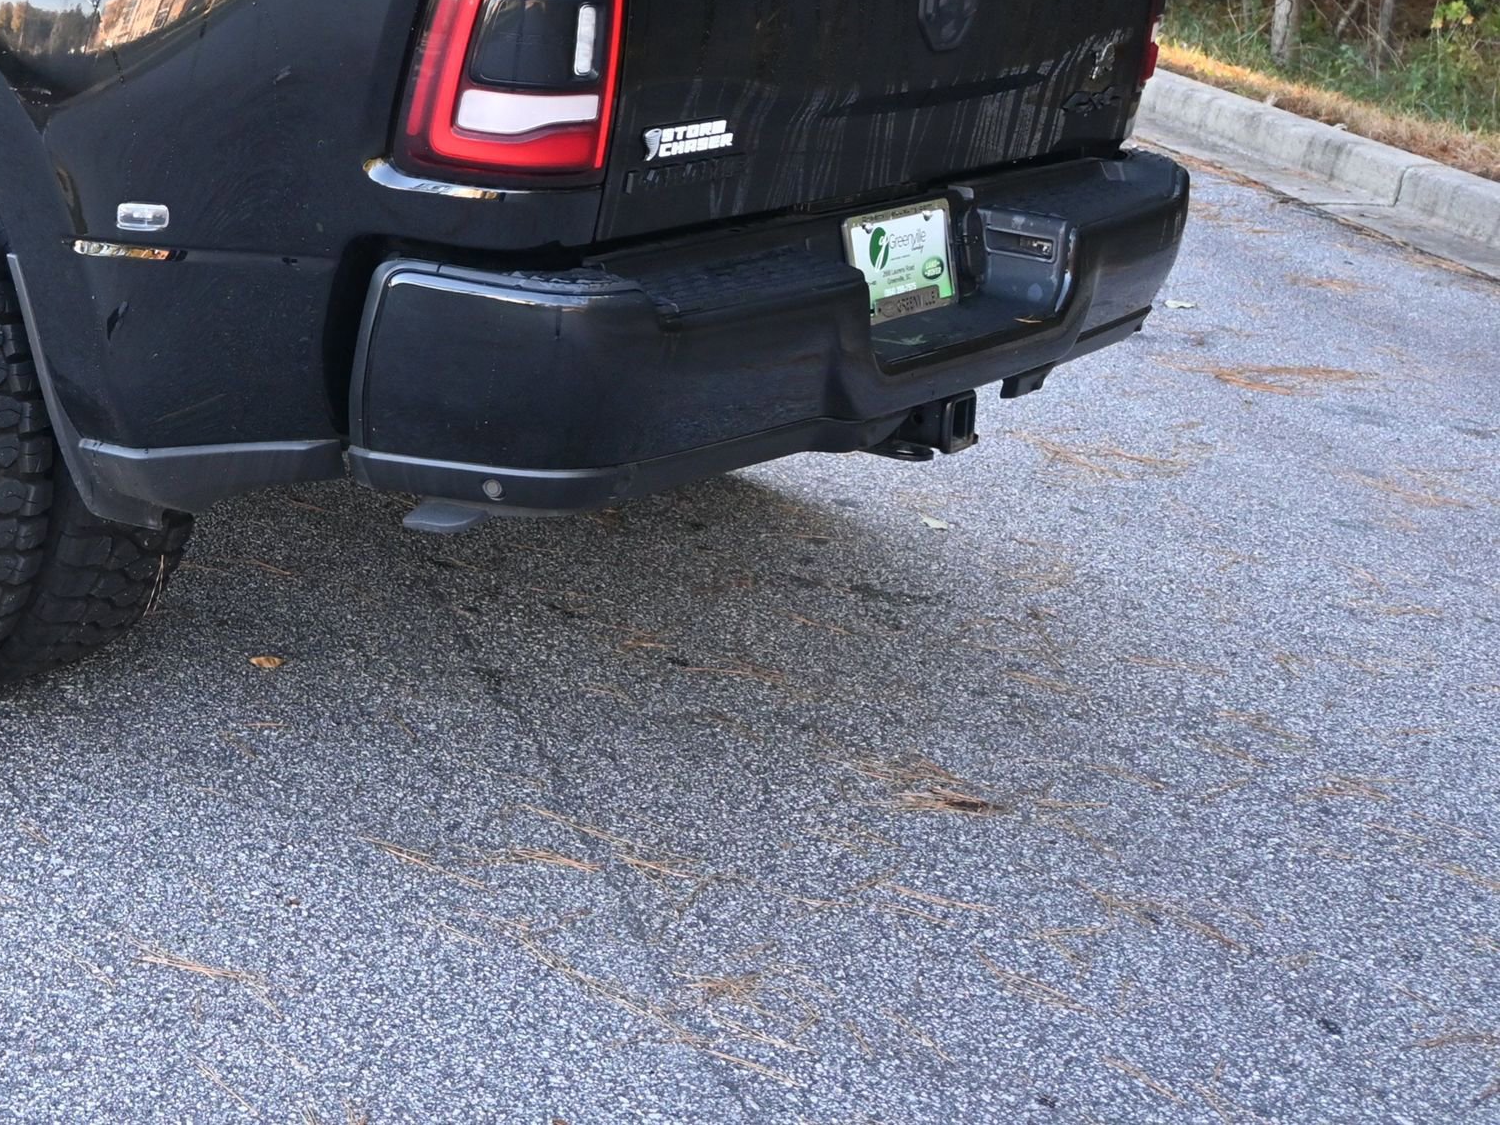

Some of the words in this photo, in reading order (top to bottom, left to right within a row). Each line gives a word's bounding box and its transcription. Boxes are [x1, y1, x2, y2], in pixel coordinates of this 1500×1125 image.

[660, 119, 728, 143] STORM
[658, 132, 734, 158] CHASER
[889, 228, 927, 250] Greenville
